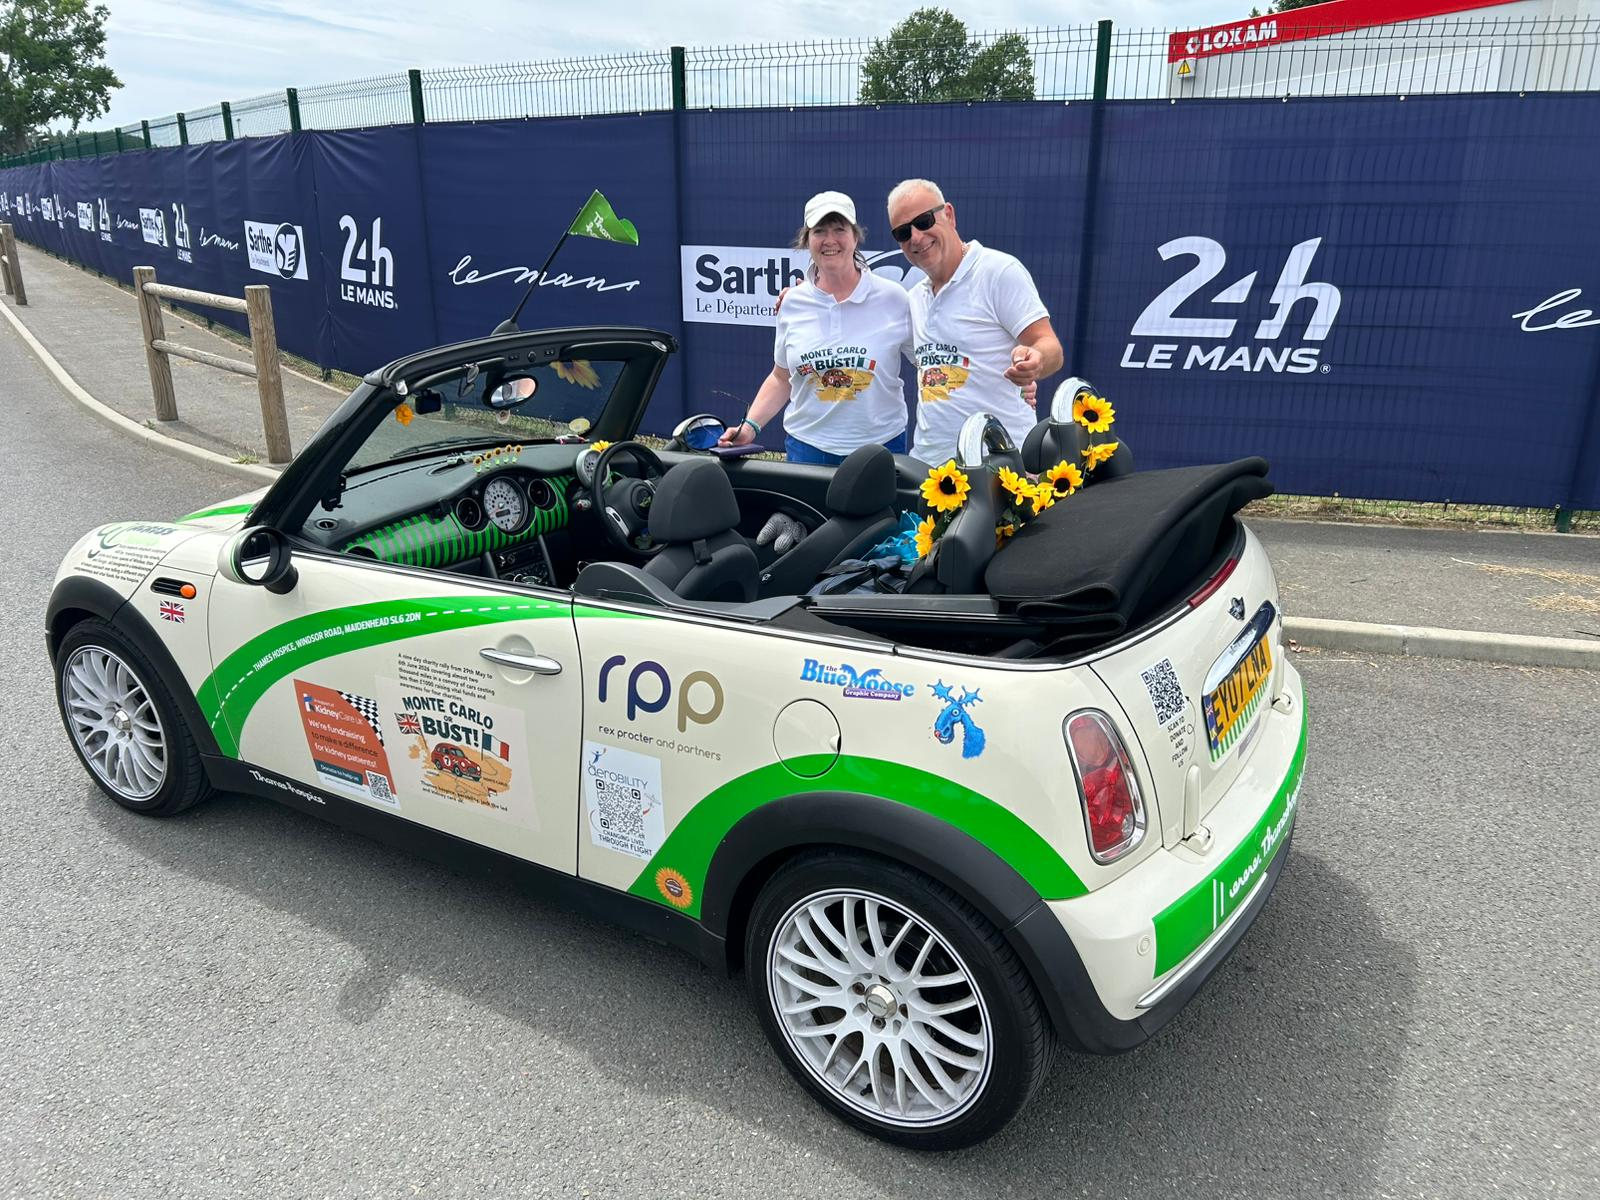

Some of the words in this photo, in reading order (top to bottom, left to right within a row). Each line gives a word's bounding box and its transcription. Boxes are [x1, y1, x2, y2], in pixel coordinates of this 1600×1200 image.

[1202, 20, 1278, 51] LOXAM
[172, 202, 190, 249] 24h
[248, 226, 273, 255] Sarthe
[339, 214, 394, 287] 24h
[512, 266, 641, 292] mans
[695, 253, 805, 296] Sarth
[341, 283, 355, 302] LE
[1130, 235, 1342, 341] 24h
[696, 298, 712, 313] Le
[800, 348, 833, 363] MONTE
[836, 346, 867, 355] CARLO
[920, 354, 951, 366] BUST!
[935, 343, 957, 353] CARLO
[1120, 343, 1178, 369] LE
[815, 356, 855, 371] BUST!
[253, 653, 273, 671] THAMES
[271, 642, 297, 660] HOSPICE,
[295, 631, 324, 648] WINDSOR
[323, 626, 344, 639] ROAD,
[344, 616, 389, 634] MAIDENHEAD
[390, 614, 404, 624] SL6
[406, 612, 421, 622] 2DN
[826, 665, 838, 673] the
[598, 655, 724, 733] rpp
[845, 688, 869, 697] Graphic
[870, 691, 900, 699] Company
[402, 697, 446, 713] MONTE
[449, 702, 494, 730] CARLO
[1167, 720, 1180, 733] SCAN
[421, 716, 480, 748] BUST!
[598, 725, 615, 736] rex
[617, 729, 654, 744] procter
[656, 738, 676, 750] and
[677, 743, 721, 761] partners
[1169, 725, 1187, 743] DONATE
[1175, 738, 1184, 749] AND
[598, 833, 630, 849] THROUGH
[630, 843, 653, 856] FLIGHT
